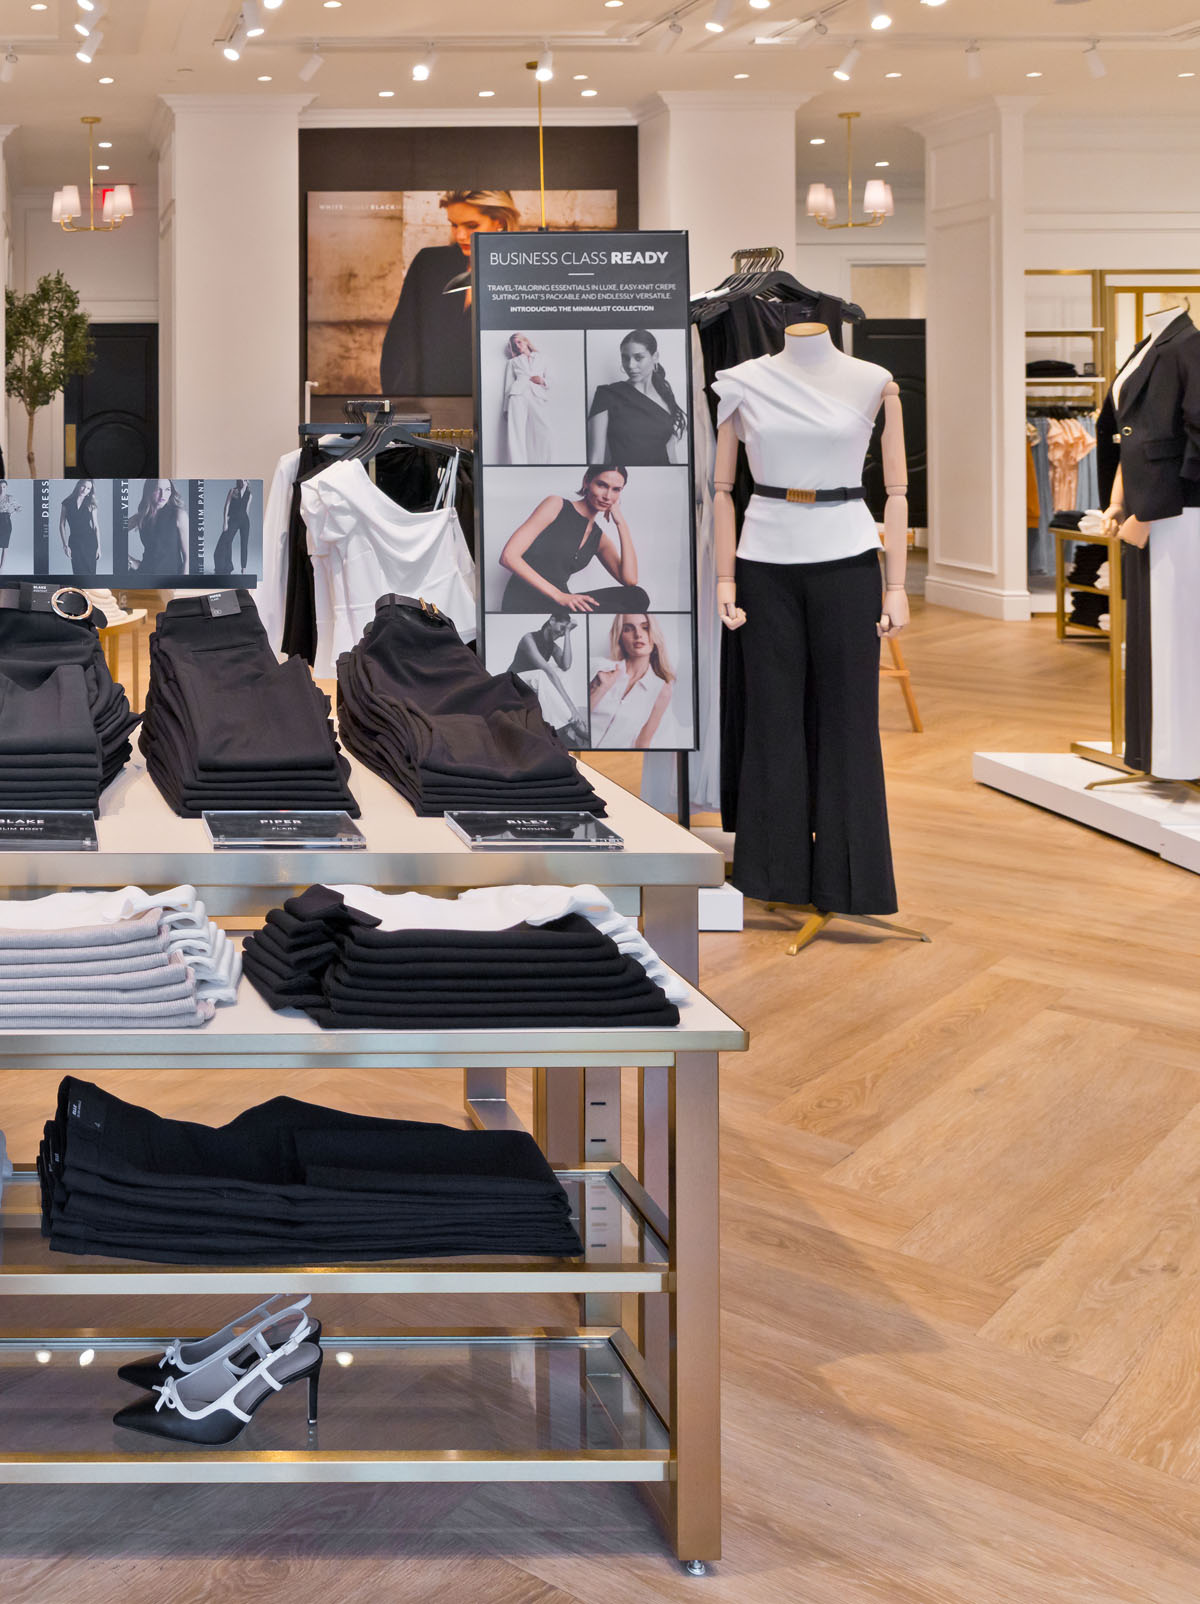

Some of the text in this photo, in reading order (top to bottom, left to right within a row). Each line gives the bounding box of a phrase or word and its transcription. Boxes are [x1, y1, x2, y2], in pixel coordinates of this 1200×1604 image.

[490, 251, 668, 266] BUSINESS CLASS READY
[488, 284, 550, 292] TRAVEL-TAILORING
[620, 283, 653, 291] EASY-KNIT
[492, 293, 520, 301] SUITING
[41, 480, 49, 517] DRESS
[121, 480, 129, 509] VEST
